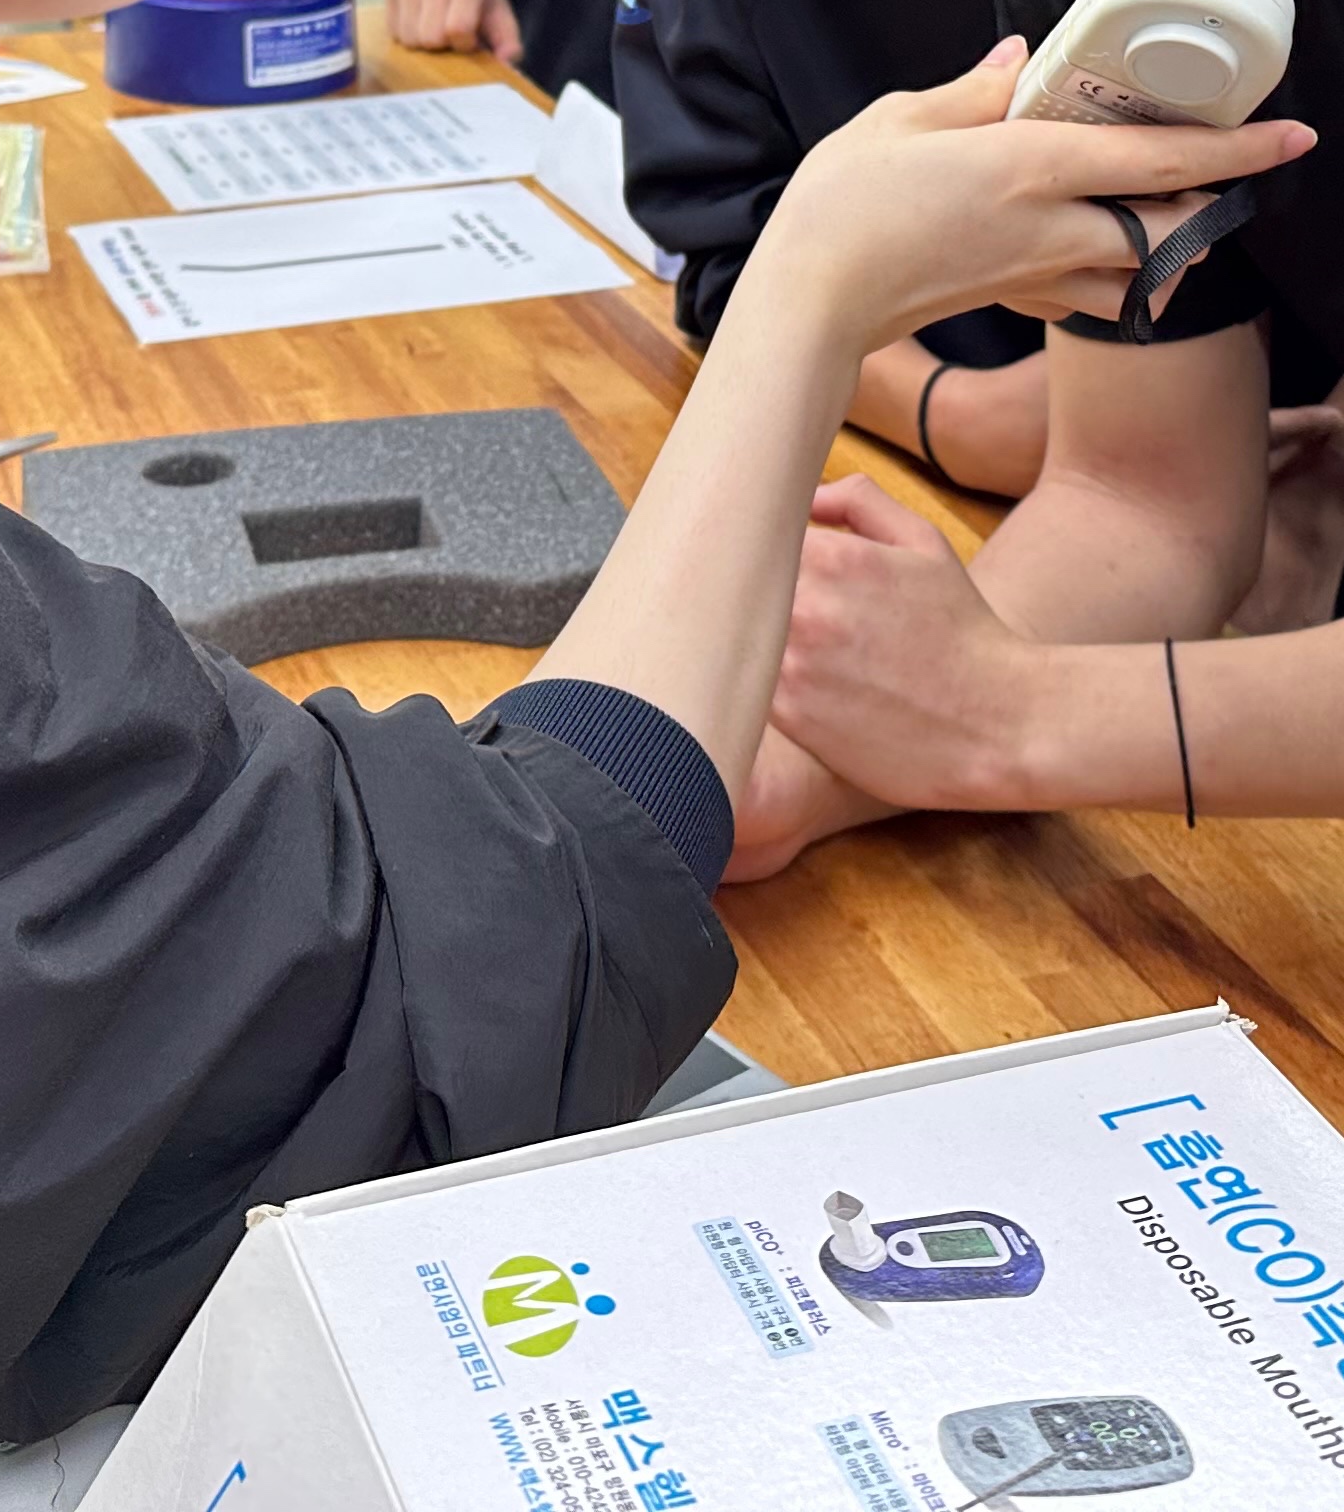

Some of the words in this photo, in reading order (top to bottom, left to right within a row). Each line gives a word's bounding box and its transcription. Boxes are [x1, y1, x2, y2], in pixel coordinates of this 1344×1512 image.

[736, 1281, 763, 1309] 사용시
[753, 1277, 780, 1305] 사용시
[1117, 1194, 1255, 1346] Disposable
[416, 1262, 471, 1339] 금연사업의
[456, 1341, 498, 1392] 파트너
[785, 1275, 832, 1336] 피코플러스
[518, 1406, 541, 1427] Tel
[531, 1437, 559, 1463] (02)
[540, 1402, 572, 1444] Mobile
[565, 1399, 596, 1434] 서울시
[586, 1436, 617, 1472] 마포구
[912, 1473, 951, 1512] 마이크
